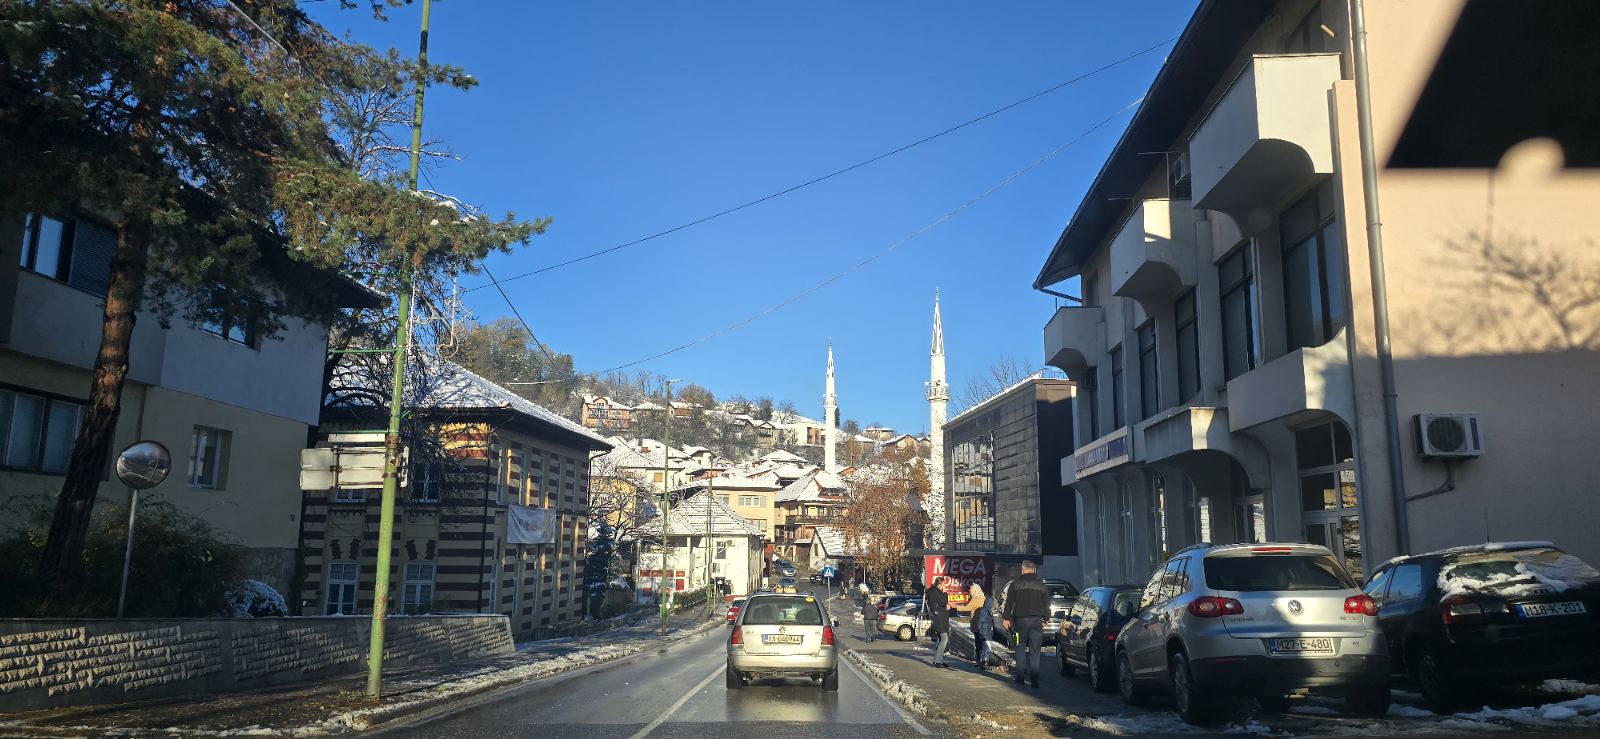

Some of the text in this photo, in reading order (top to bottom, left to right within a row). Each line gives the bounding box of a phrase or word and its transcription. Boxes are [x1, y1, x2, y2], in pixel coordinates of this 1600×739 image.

[933, 557, 986, 575] MEGA
[943, 575, 986, 587] Diskont
[1523, 601, 1583, 616] M18-K-201
[1276, 639, 1330, 650] M27-E-480
